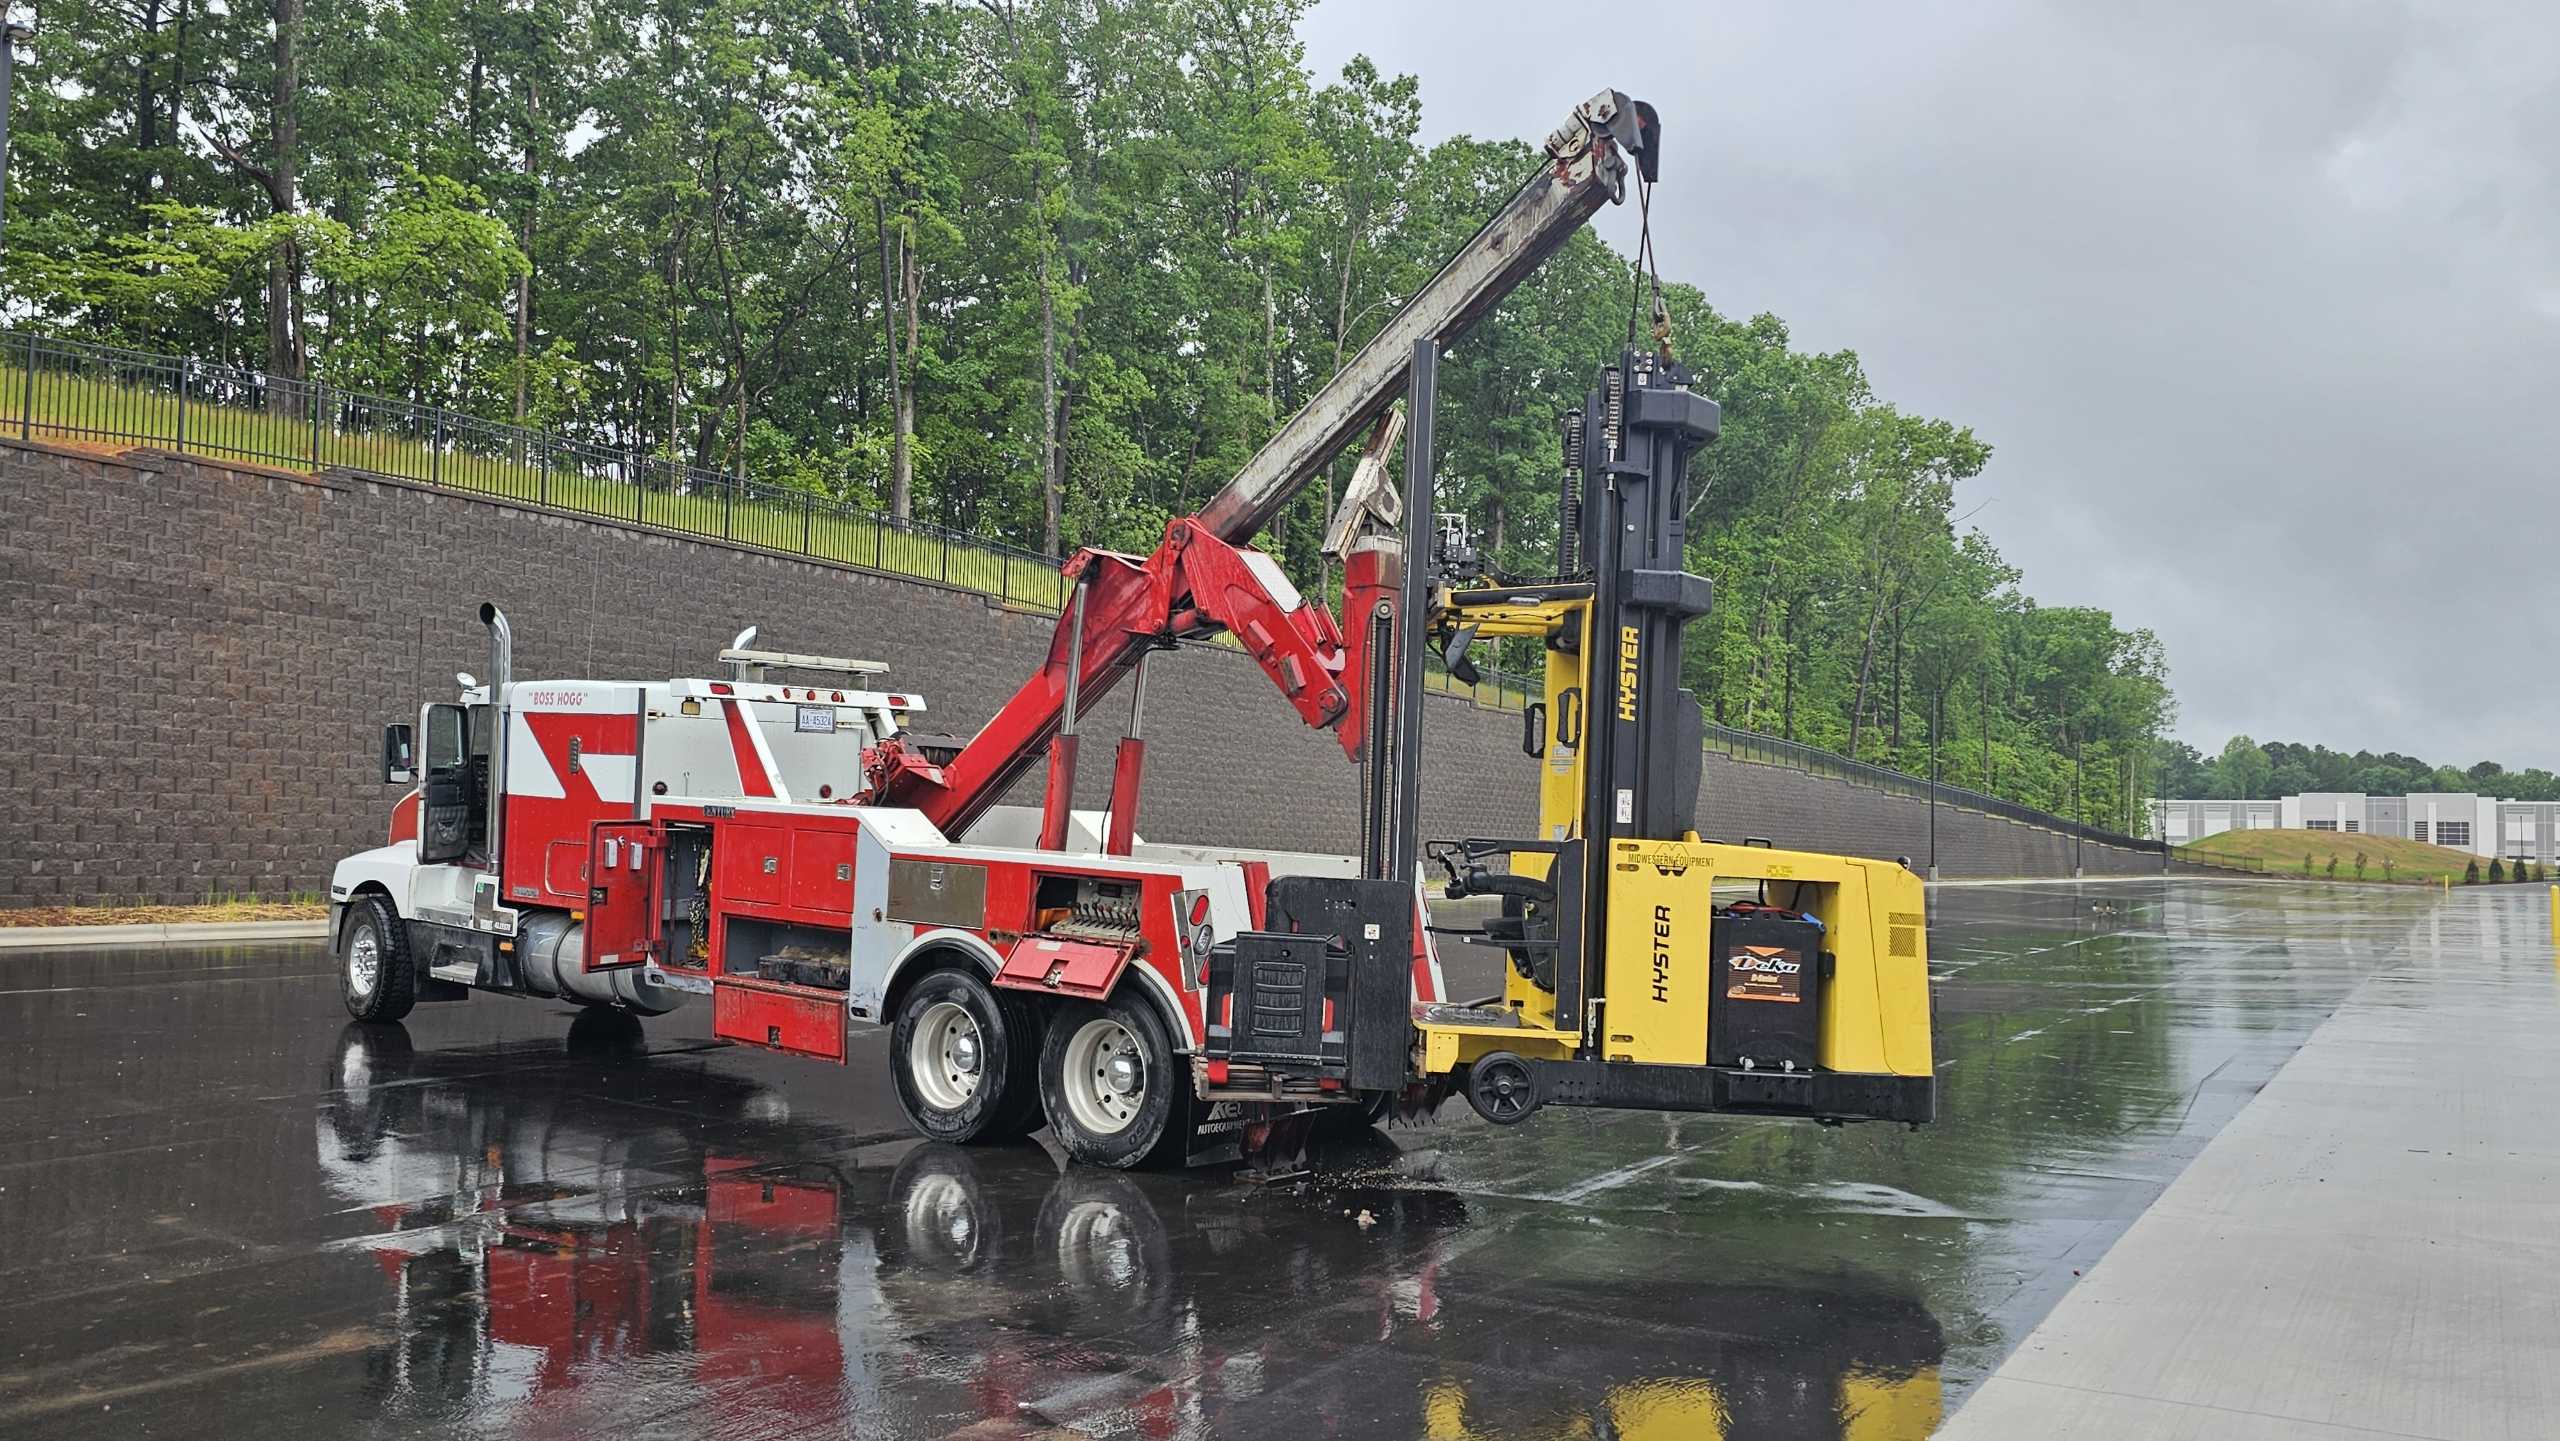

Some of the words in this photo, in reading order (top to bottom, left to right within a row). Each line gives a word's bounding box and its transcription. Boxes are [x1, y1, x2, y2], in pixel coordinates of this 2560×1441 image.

[1619, 626, 1639, 721] HYSTER
[1628, 853, 1674, 865] MIDWESTERN
[1676, 855, 1714, 867] EQUIPMENT
[1653, 905, 1671, 1003] HYSTER
[1729, 955, 1801, 974] Deka
